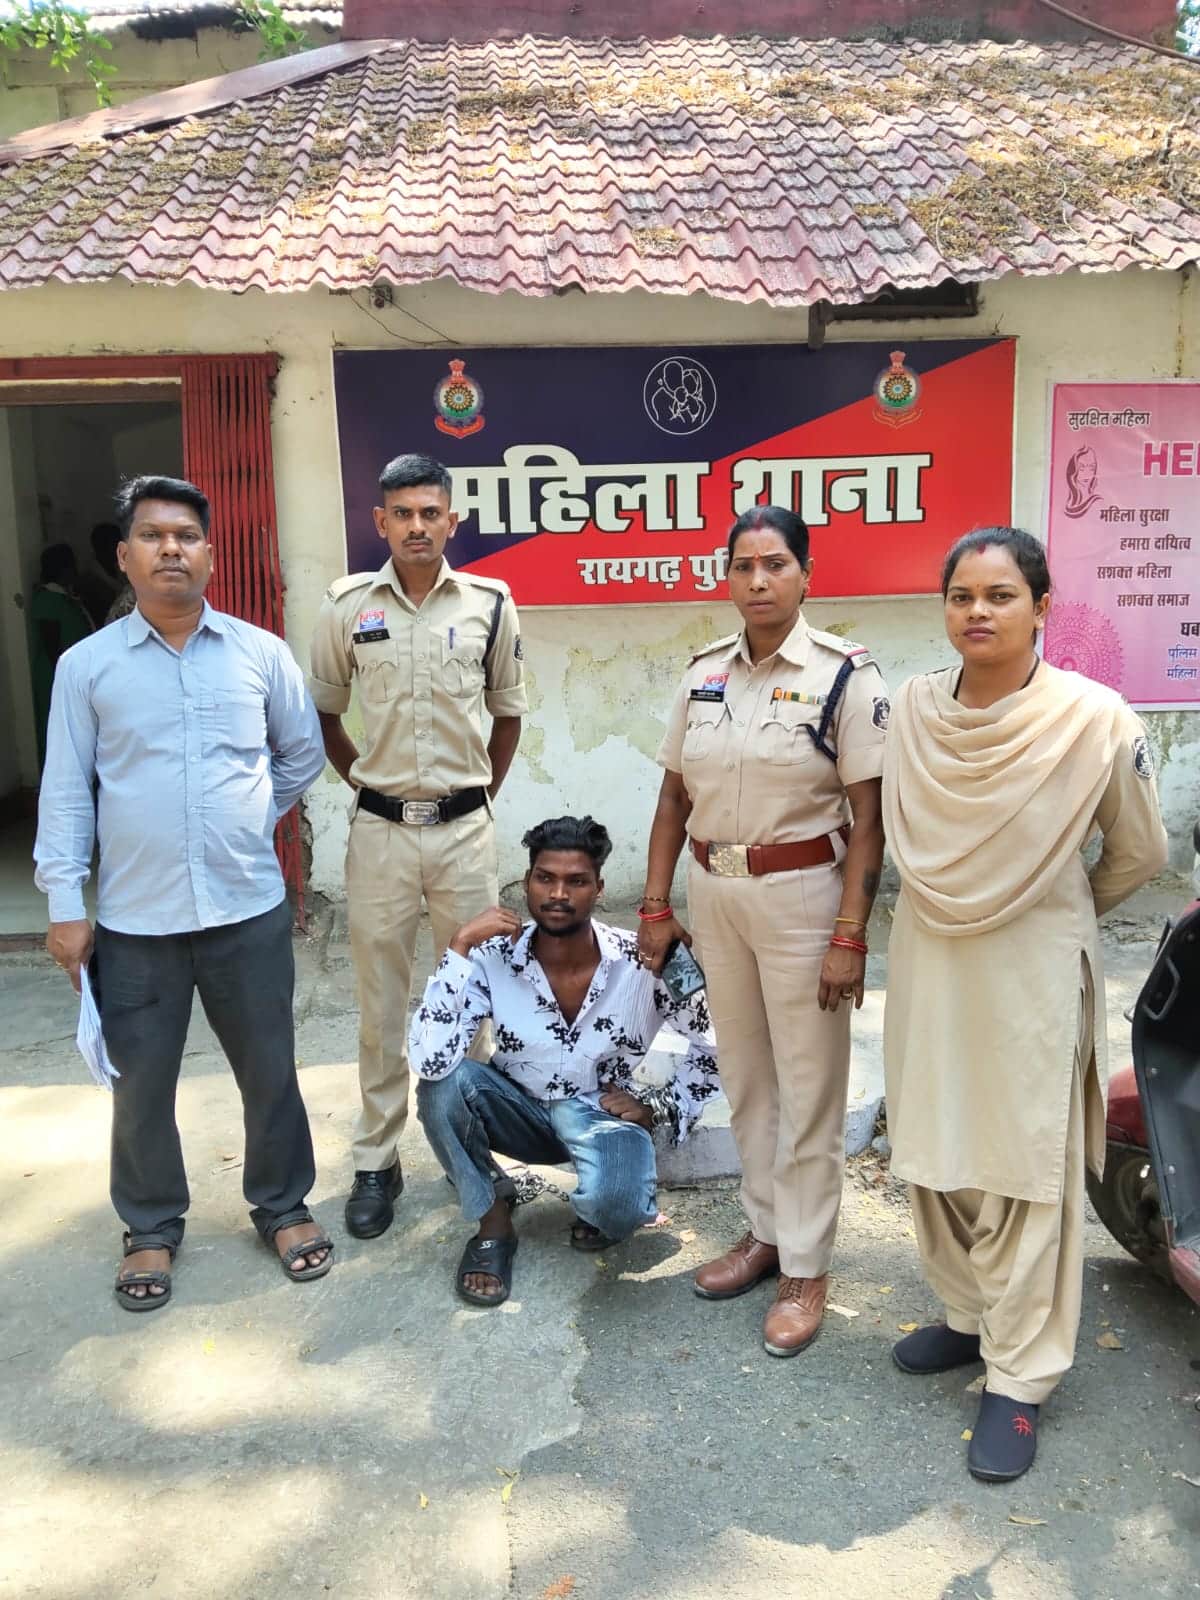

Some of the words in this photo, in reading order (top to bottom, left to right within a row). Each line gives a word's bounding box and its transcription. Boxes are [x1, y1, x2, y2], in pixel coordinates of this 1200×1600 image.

[1068, 408, 1109, 430] सुरक्षित
[1112, 408, 1150, 427] महिला
[1144, 442, 1200, 476] HE
[446, 444, 711, 535] महिला
[731, 453, 933, 526] थाना
[1099, 505, 1136, 522] महिला
[1139, 508, 1170, 527] सुरक्षा
[1119, 537, 1151, 550] हमारा
[1154, 533, 1192, 550] दायित्व
[576, 555, 684, 590] रायगढ़
[1096, 566, 1133, 579] सशक्त
[1136, 562, 1172, 579] महिला
[1117, 594, 1154, 607] सशक्त
[1157, 594, 1190, 606] समाज
[1180, 622, 1200, 636] घब
[1167, 665, 1197, 679] महिला
